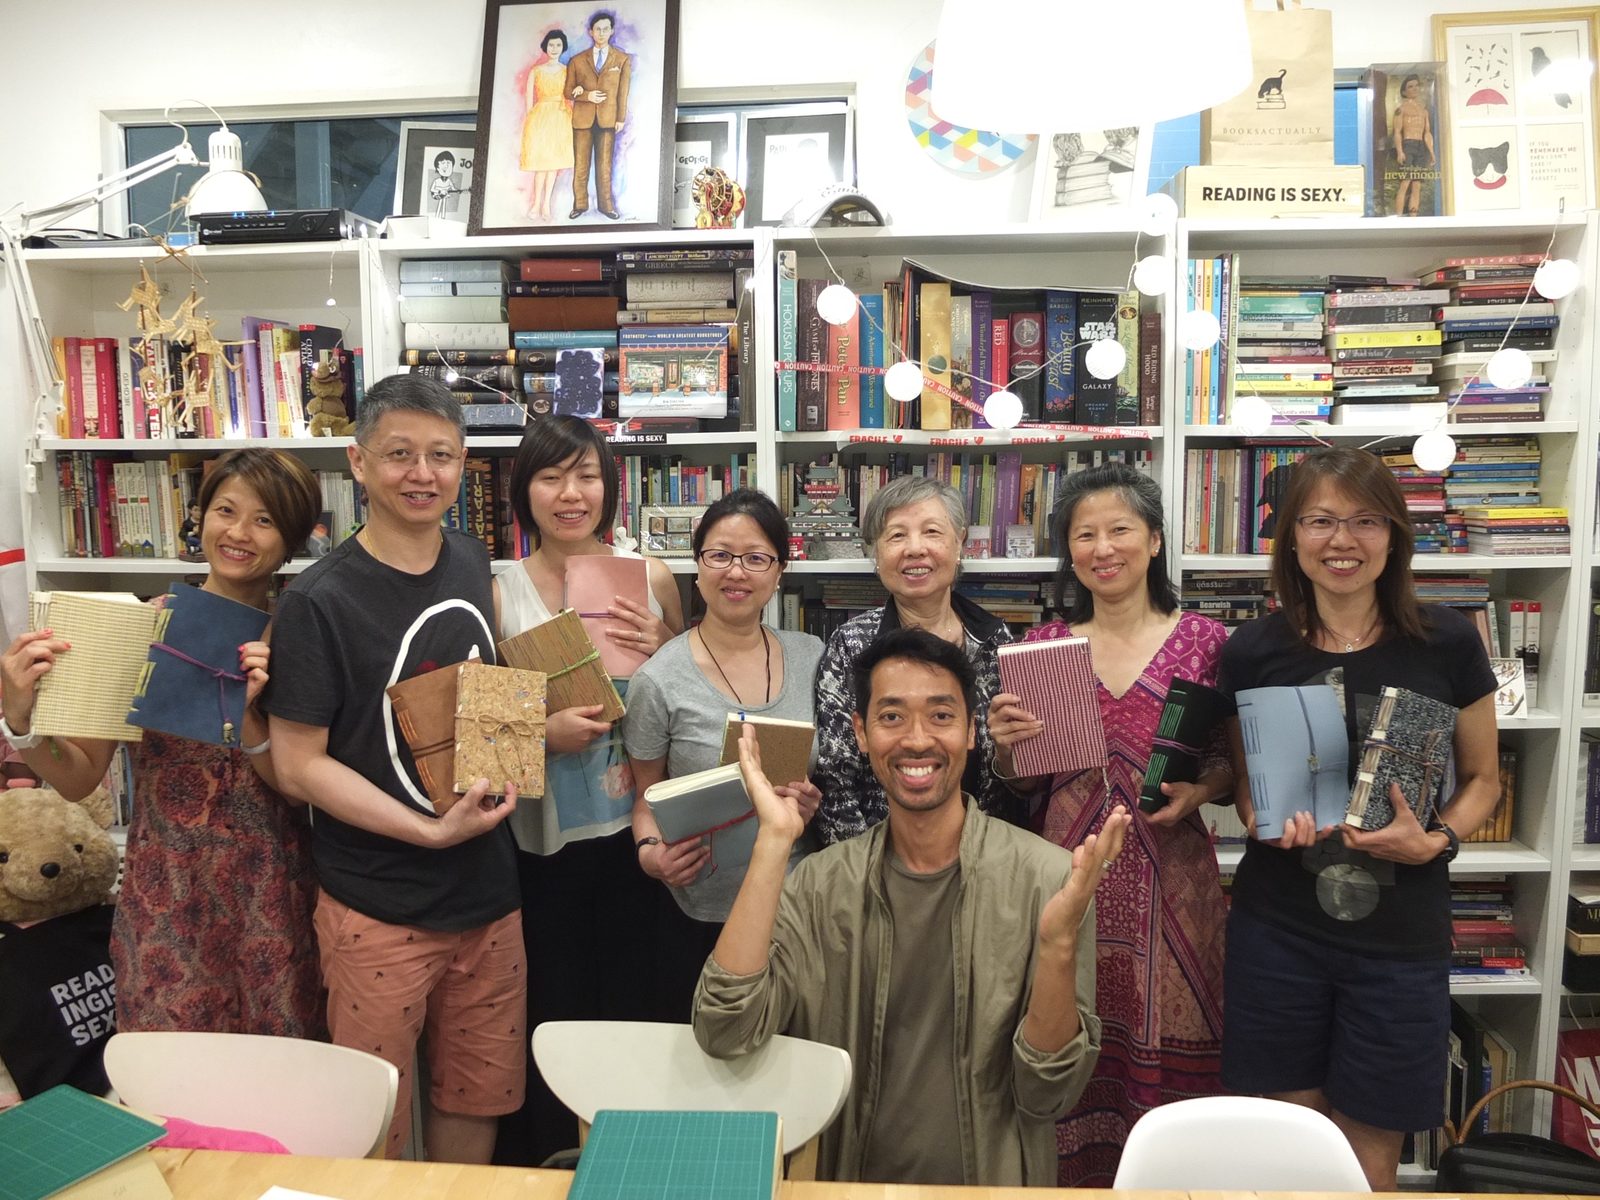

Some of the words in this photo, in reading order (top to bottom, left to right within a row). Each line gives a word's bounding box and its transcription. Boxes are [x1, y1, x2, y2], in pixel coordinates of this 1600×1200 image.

[1222, 127, 1322, 135] BOOKSACTUALLY
[678, 155, 709, 165] GEORGE
[1384, 170, 1406, 180] new
[1202, 186, 1276, 202] READING
[1281, 188, 1297, 201] IS
[1301, 188, 1346, 202] SEXY.
[783, 303, 793, 347] HOKUSAI
[994, 325, 1002, 346] RED
[1079, 330, 1116, 341] WARS
[1083, 321, 1116, 332] STAR
[978, 323, 987, 356] Wonderful
[300, 341, 308, 365] ATLAS
[1058, 329, 1075, 376] Beauty
[785, 361, 812, 370] CAUTION
[817, 363, 845, 373] CAUTION
[848, 366, 875, 374] CAUTION
[1047, 349, 1063, 391] Beast
[837, 379, 851, 406] Pan
[937, 384, 963, 405] CAUTION
[149, 409, 160, 439] TED
[1056, 424, 1083, 432] CAUTION
[1087, 426, 1116, 434] CAUTION
[1120, 429, 1147, 438] CAUTION
[606, 434, 637, 443] READING
[637, 434, 645, 442] IS
[645, 434, 665, 443] SEXY.
[849, 435, 888, 444] FRAGILE
[929, 437, 969, 446] FRAGILE
[1011, 437, 1050, 446] FRAGILE
[472, 472, 485, 540] AFARI
[51, 963, 116, 1005] READ
